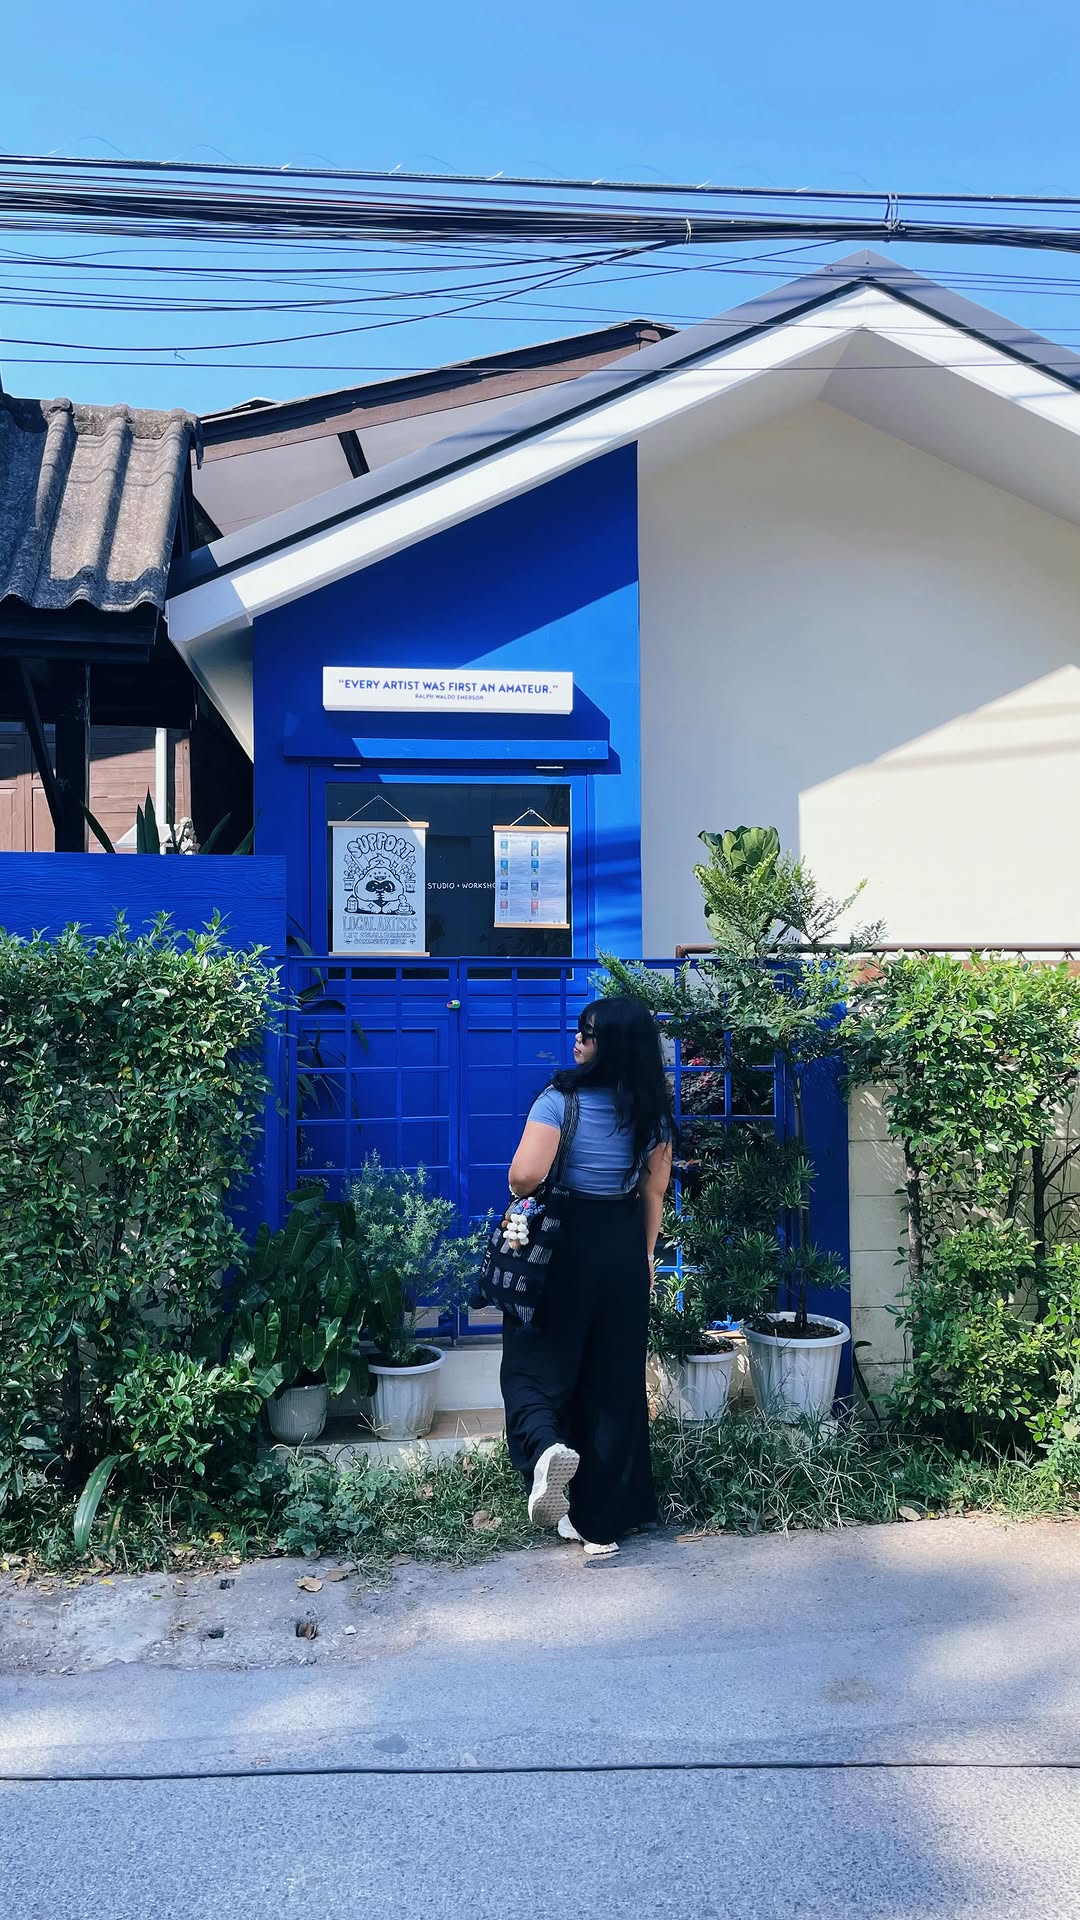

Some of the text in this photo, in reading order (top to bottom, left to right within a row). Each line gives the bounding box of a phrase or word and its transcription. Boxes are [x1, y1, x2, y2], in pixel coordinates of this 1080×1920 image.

[383, 680, 420, 690] ARTIST
[422, 681, 446, 691] WAS
[448, 682, 477, 692] FIRST
[480, 683, 496, 692] AN
[347, 832, 415, 859] SUPPORT
[427, 882, 455, 890] STUDIO
[343, 915, 418, 931] LOCAL ARTISTS
